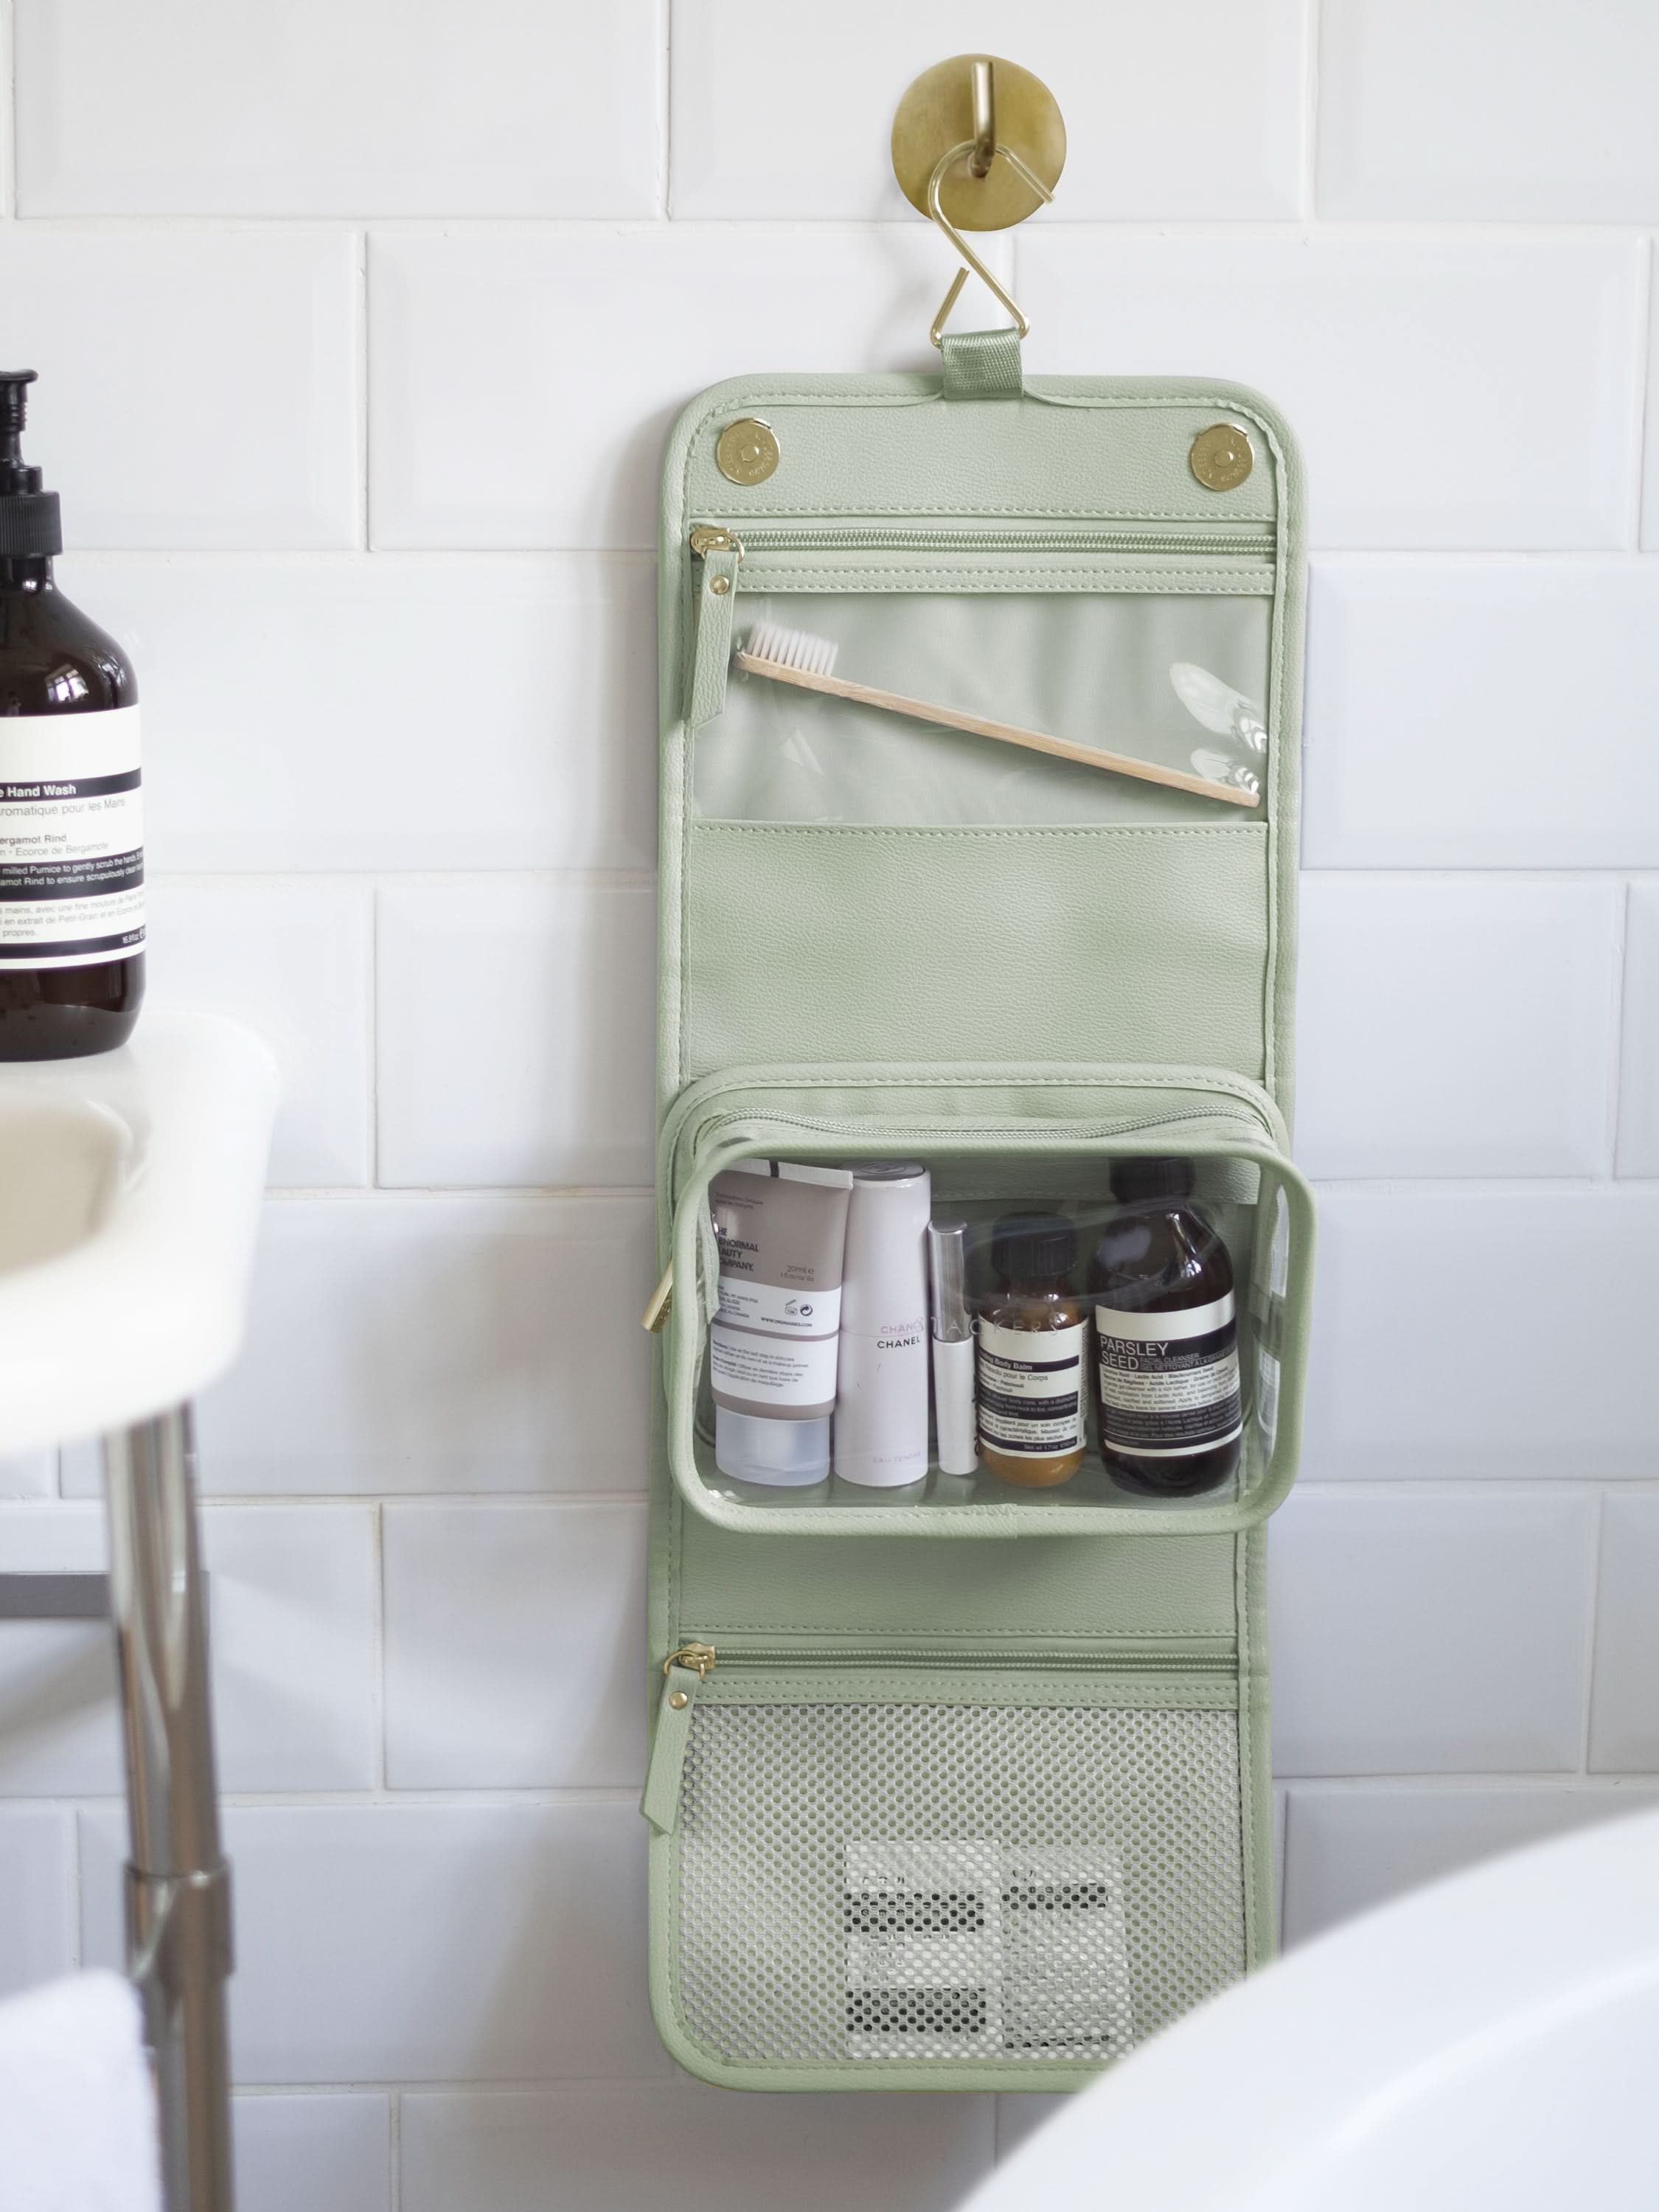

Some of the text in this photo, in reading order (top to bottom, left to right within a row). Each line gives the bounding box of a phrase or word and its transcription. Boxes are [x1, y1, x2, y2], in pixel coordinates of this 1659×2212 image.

[7, 786, 41, 797] Hand
[43, 783, 77, 796] Wash
[88, 801, 102, 811] les
[44, 834, 67, 844] Rind
[2, 866, 29, 875] milled
[29, 866, 62, 874] Pumice
[63, 865, 72, 873] to
[72, 862, 95, 874] gently
[95, 860, 114, 869] scrub
[24, 877, 45, 886] Rind
[46, 876, 55, 885] to
[57, 874, 85, 885] ensure
[86, 869, 125, 882] scrupulously
[35, 906, 56, 914] avec
[717, 1226, 728, 1237] HE
[718, 1237, 760, 1253] BNORMAL
[719, 1256, 755, 1272] OMPANY.
[877, 1335, 921, 1349] CHANEL
[1099, 1335, 1169, 1357] PARSLEY
[994, 1357, 1012, 1369] Body
[1013, 1363, 1033, 1371] Balm
[1101, 1350, 1140, 1371] SEED
[1164, 1352, 1200, 1363] CLEANSER
[1140, 1363, 1154, 1371] GEL
[1155, 1359, 1194, 1371] NETTOYANT
